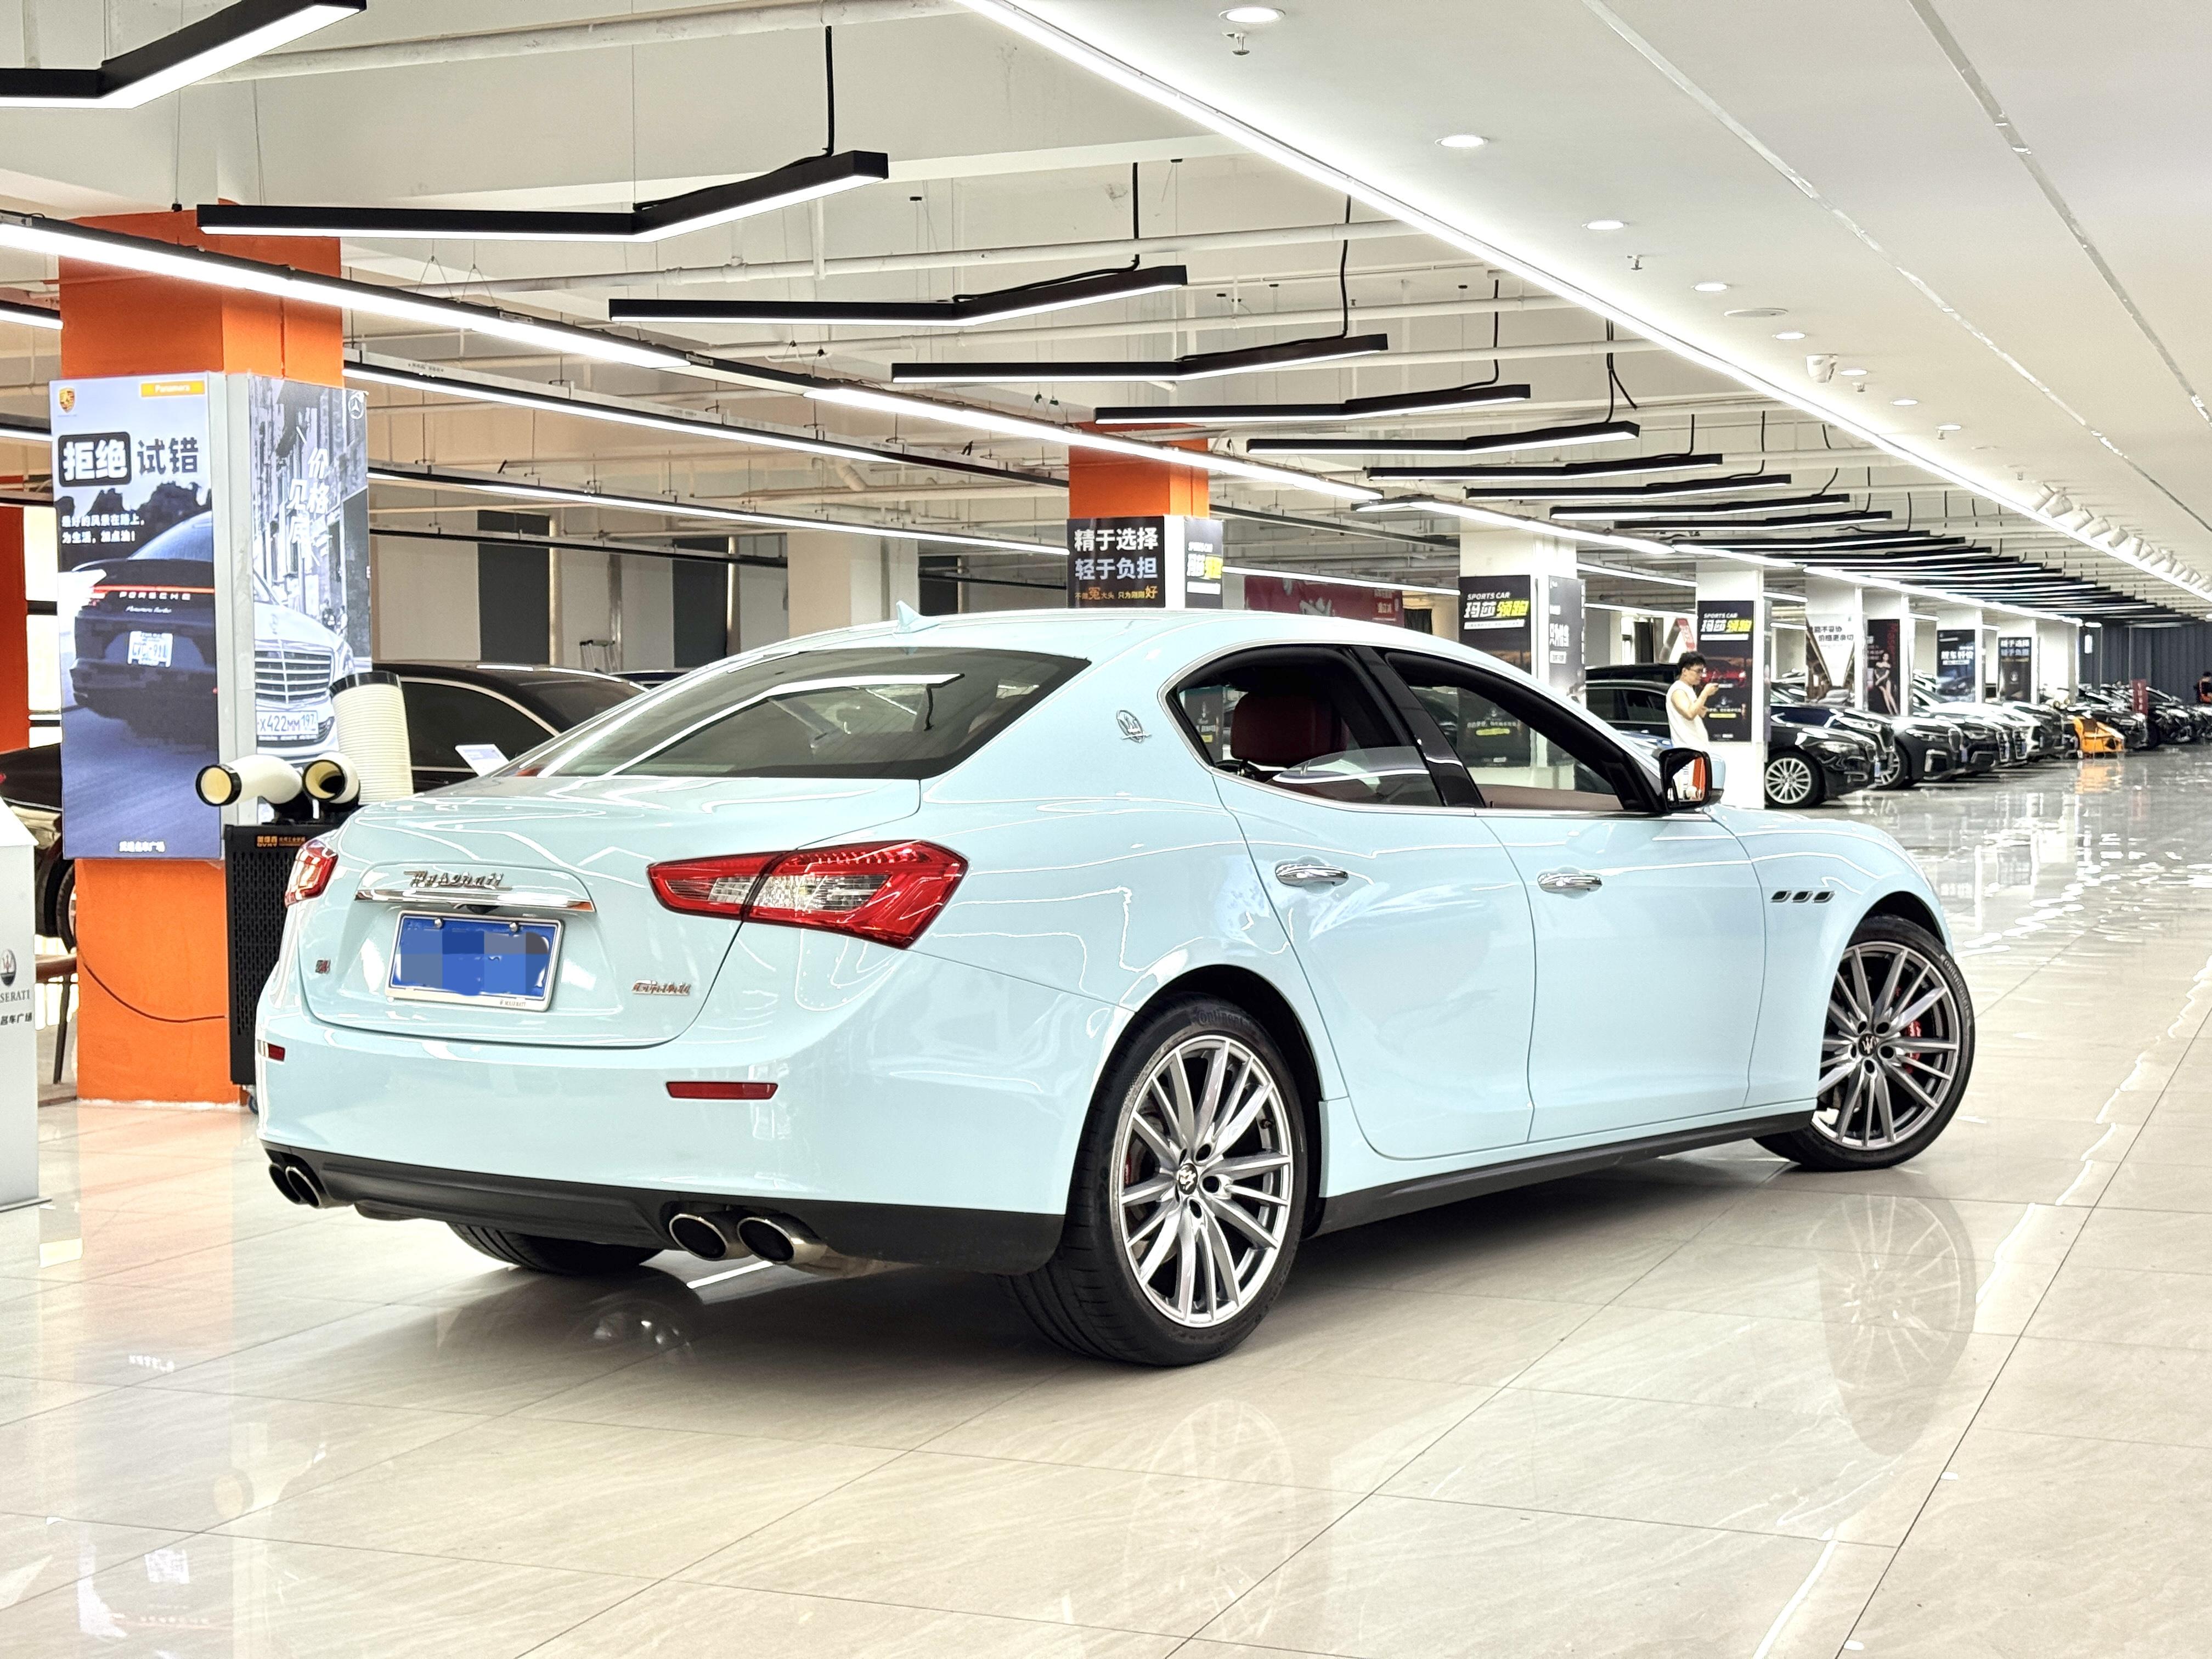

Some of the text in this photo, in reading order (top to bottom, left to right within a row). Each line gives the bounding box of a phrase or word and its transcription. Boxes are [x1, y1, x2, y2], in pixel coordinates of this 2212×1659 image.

[63, 437, 199, 482] 拒绝试错
[1074, 527, 1159, 552] 精于选择
[1075, 557, 1158, 580] 轻于负担
[119, 591, 191, 601] PORSCHE
[0, 989, 30, 1003] SERATI
